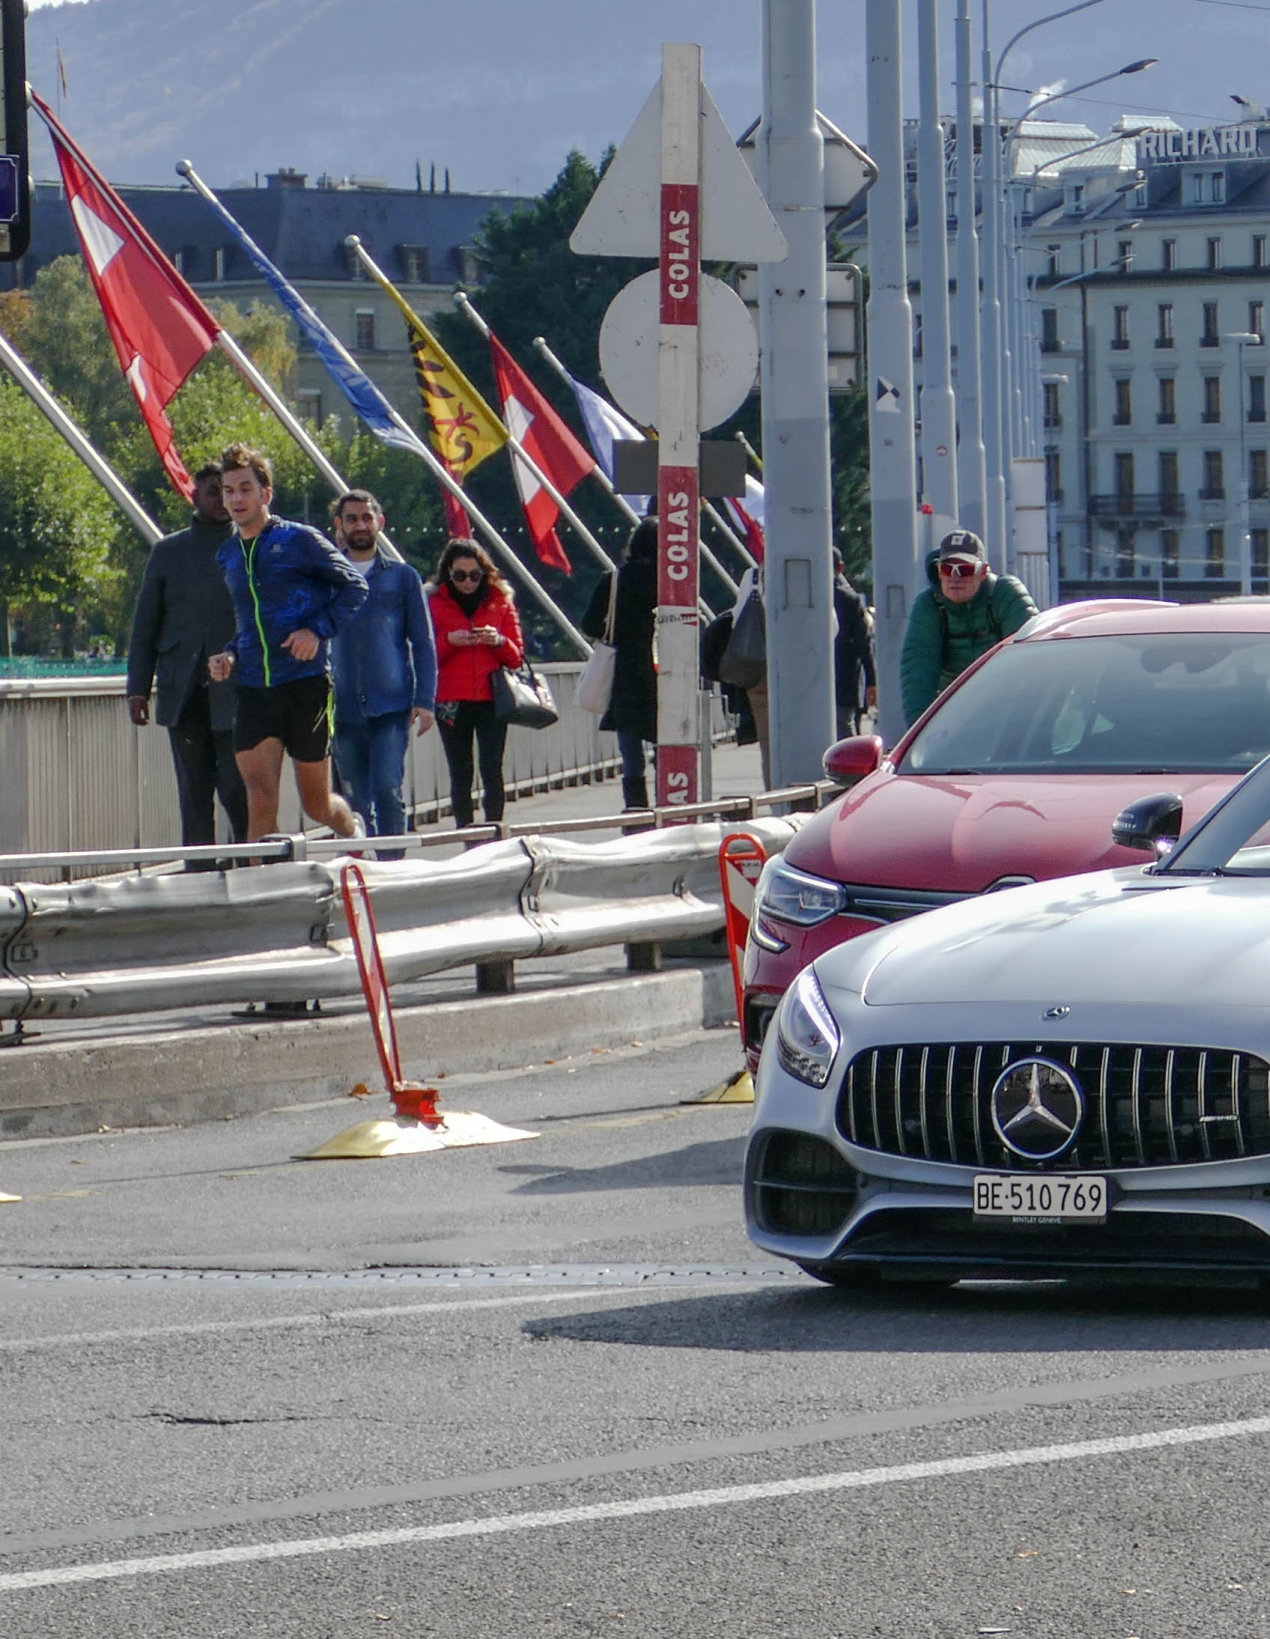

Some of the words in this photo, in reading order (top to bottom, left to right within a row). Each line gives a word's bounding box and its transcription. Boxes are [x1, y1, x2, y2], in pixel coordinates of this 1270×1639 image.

[1141, 127, 1259, 158] RICHARD
[668, 209, 690, 299] COLAS
[667, 491, 689, 581] COLAS
